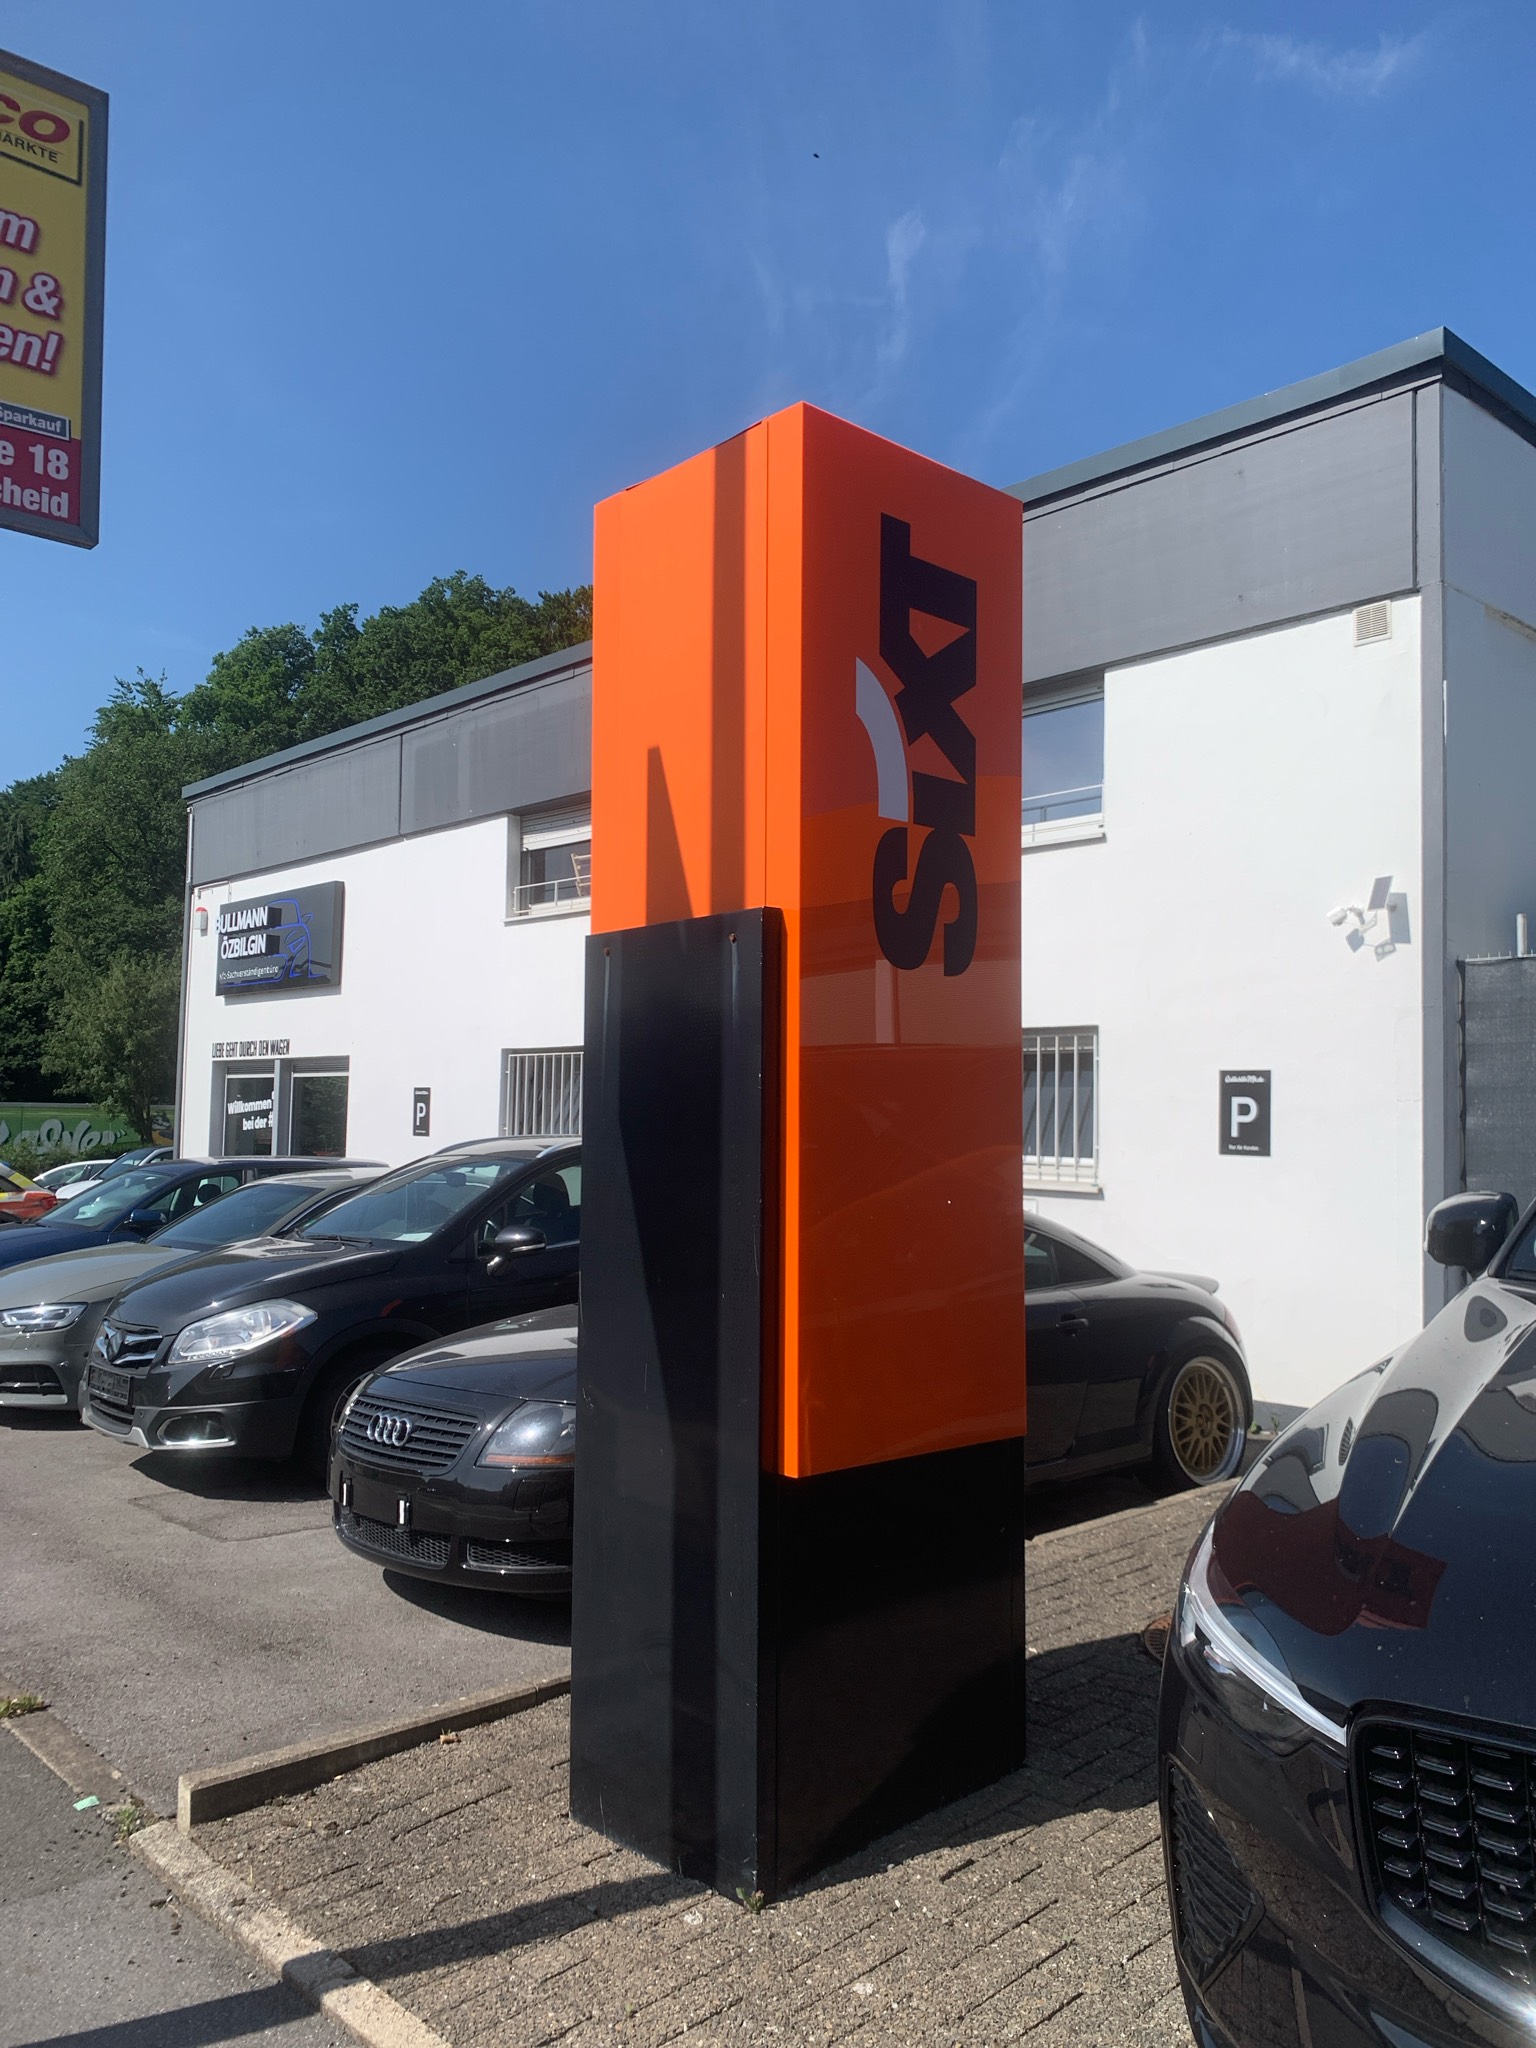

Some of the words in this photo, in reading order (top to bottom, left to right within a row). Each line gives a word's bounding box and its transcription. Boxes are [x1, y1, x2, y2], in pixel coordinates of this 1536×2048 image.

[23, 273, 61, 317] &
[28, 444, 69, 480] 18
[0, 476, 69, 518] heid
[872, 511, 978, 977] SIXT
[215, 905, 269, 934] BULLMANN
[220, 934, 267, 960] ÖZBILGIN
[225, 1042, 238, 1058] GEHT
[239, 1040, 258, 1057] DURCH
[259, 1039, 269, 1057] DEN
[269, 1038, 290, 1056] WAGEN
[227, 1098, 272, 1115] Willkommen
[416, 1102, 426, 1126] P
[1230, 1096, 1258, 1138] P
[242, 1115, 254, 1131] bei
[254, 1115, 267, 1130] der
